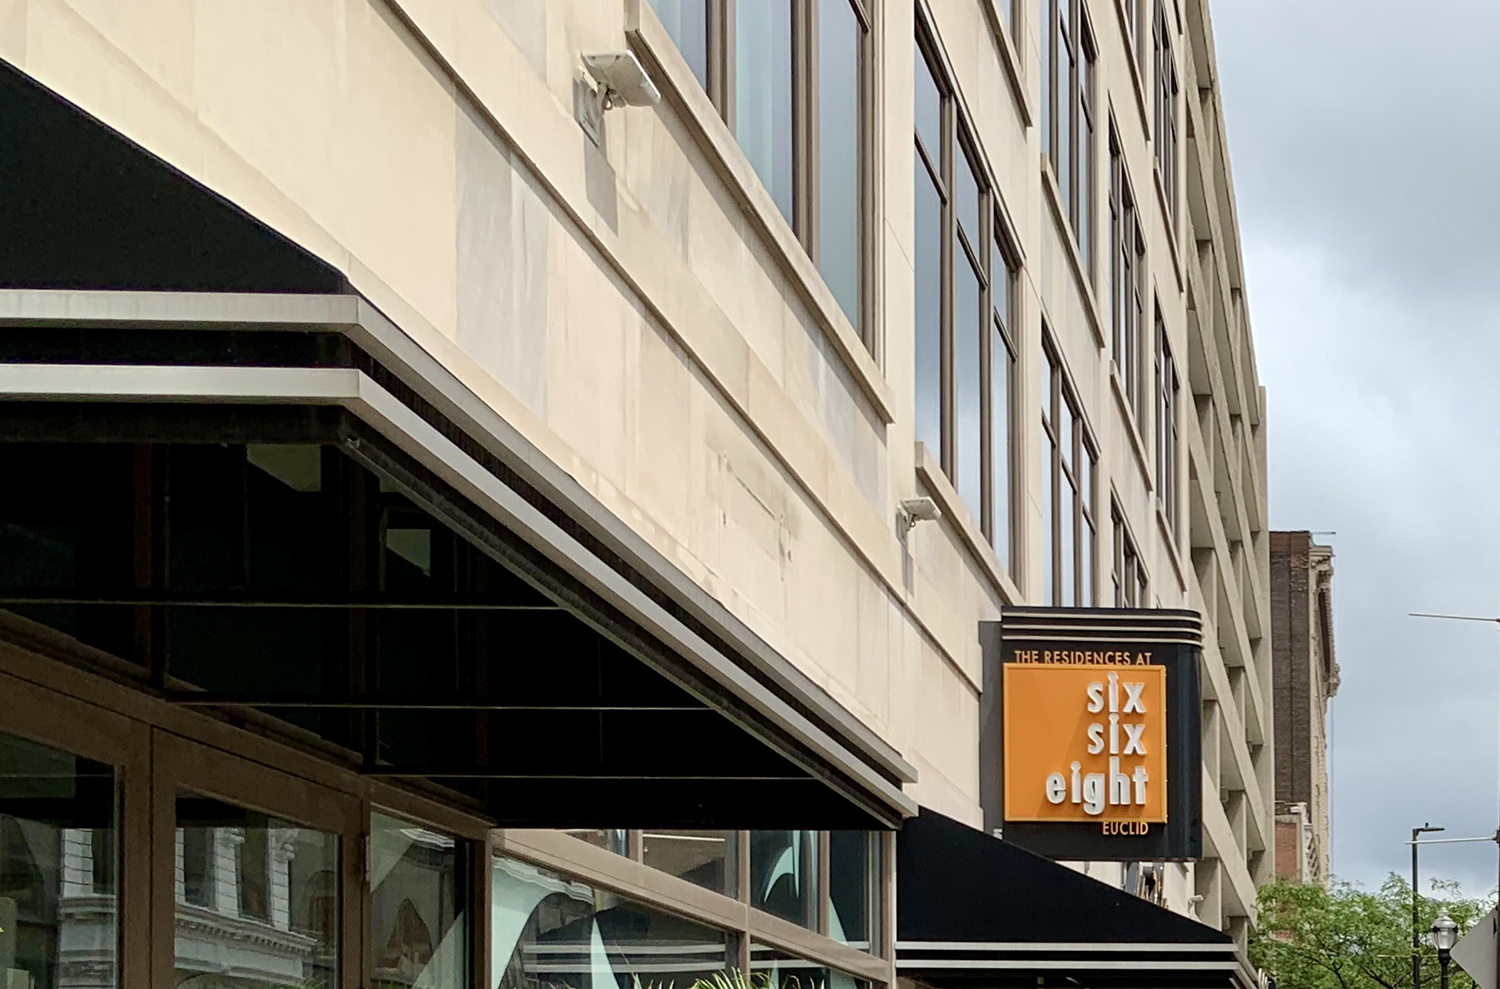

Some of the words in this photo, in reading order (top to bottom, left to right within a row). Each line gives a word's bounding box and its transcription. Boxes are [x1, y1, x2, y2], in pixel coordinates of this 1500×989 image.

[1014, 650, 1040, 664] THE
[1044, 651, 1131, 665] RESIDENCES
[1135, 652, 1152, 665] AT
[1087, 671, 1147, 714] six
[1087, 713, 1147, 756] six
[1046, 756, 1149, 815] eight
[1102, 822, 1149, 836] EUCLID
